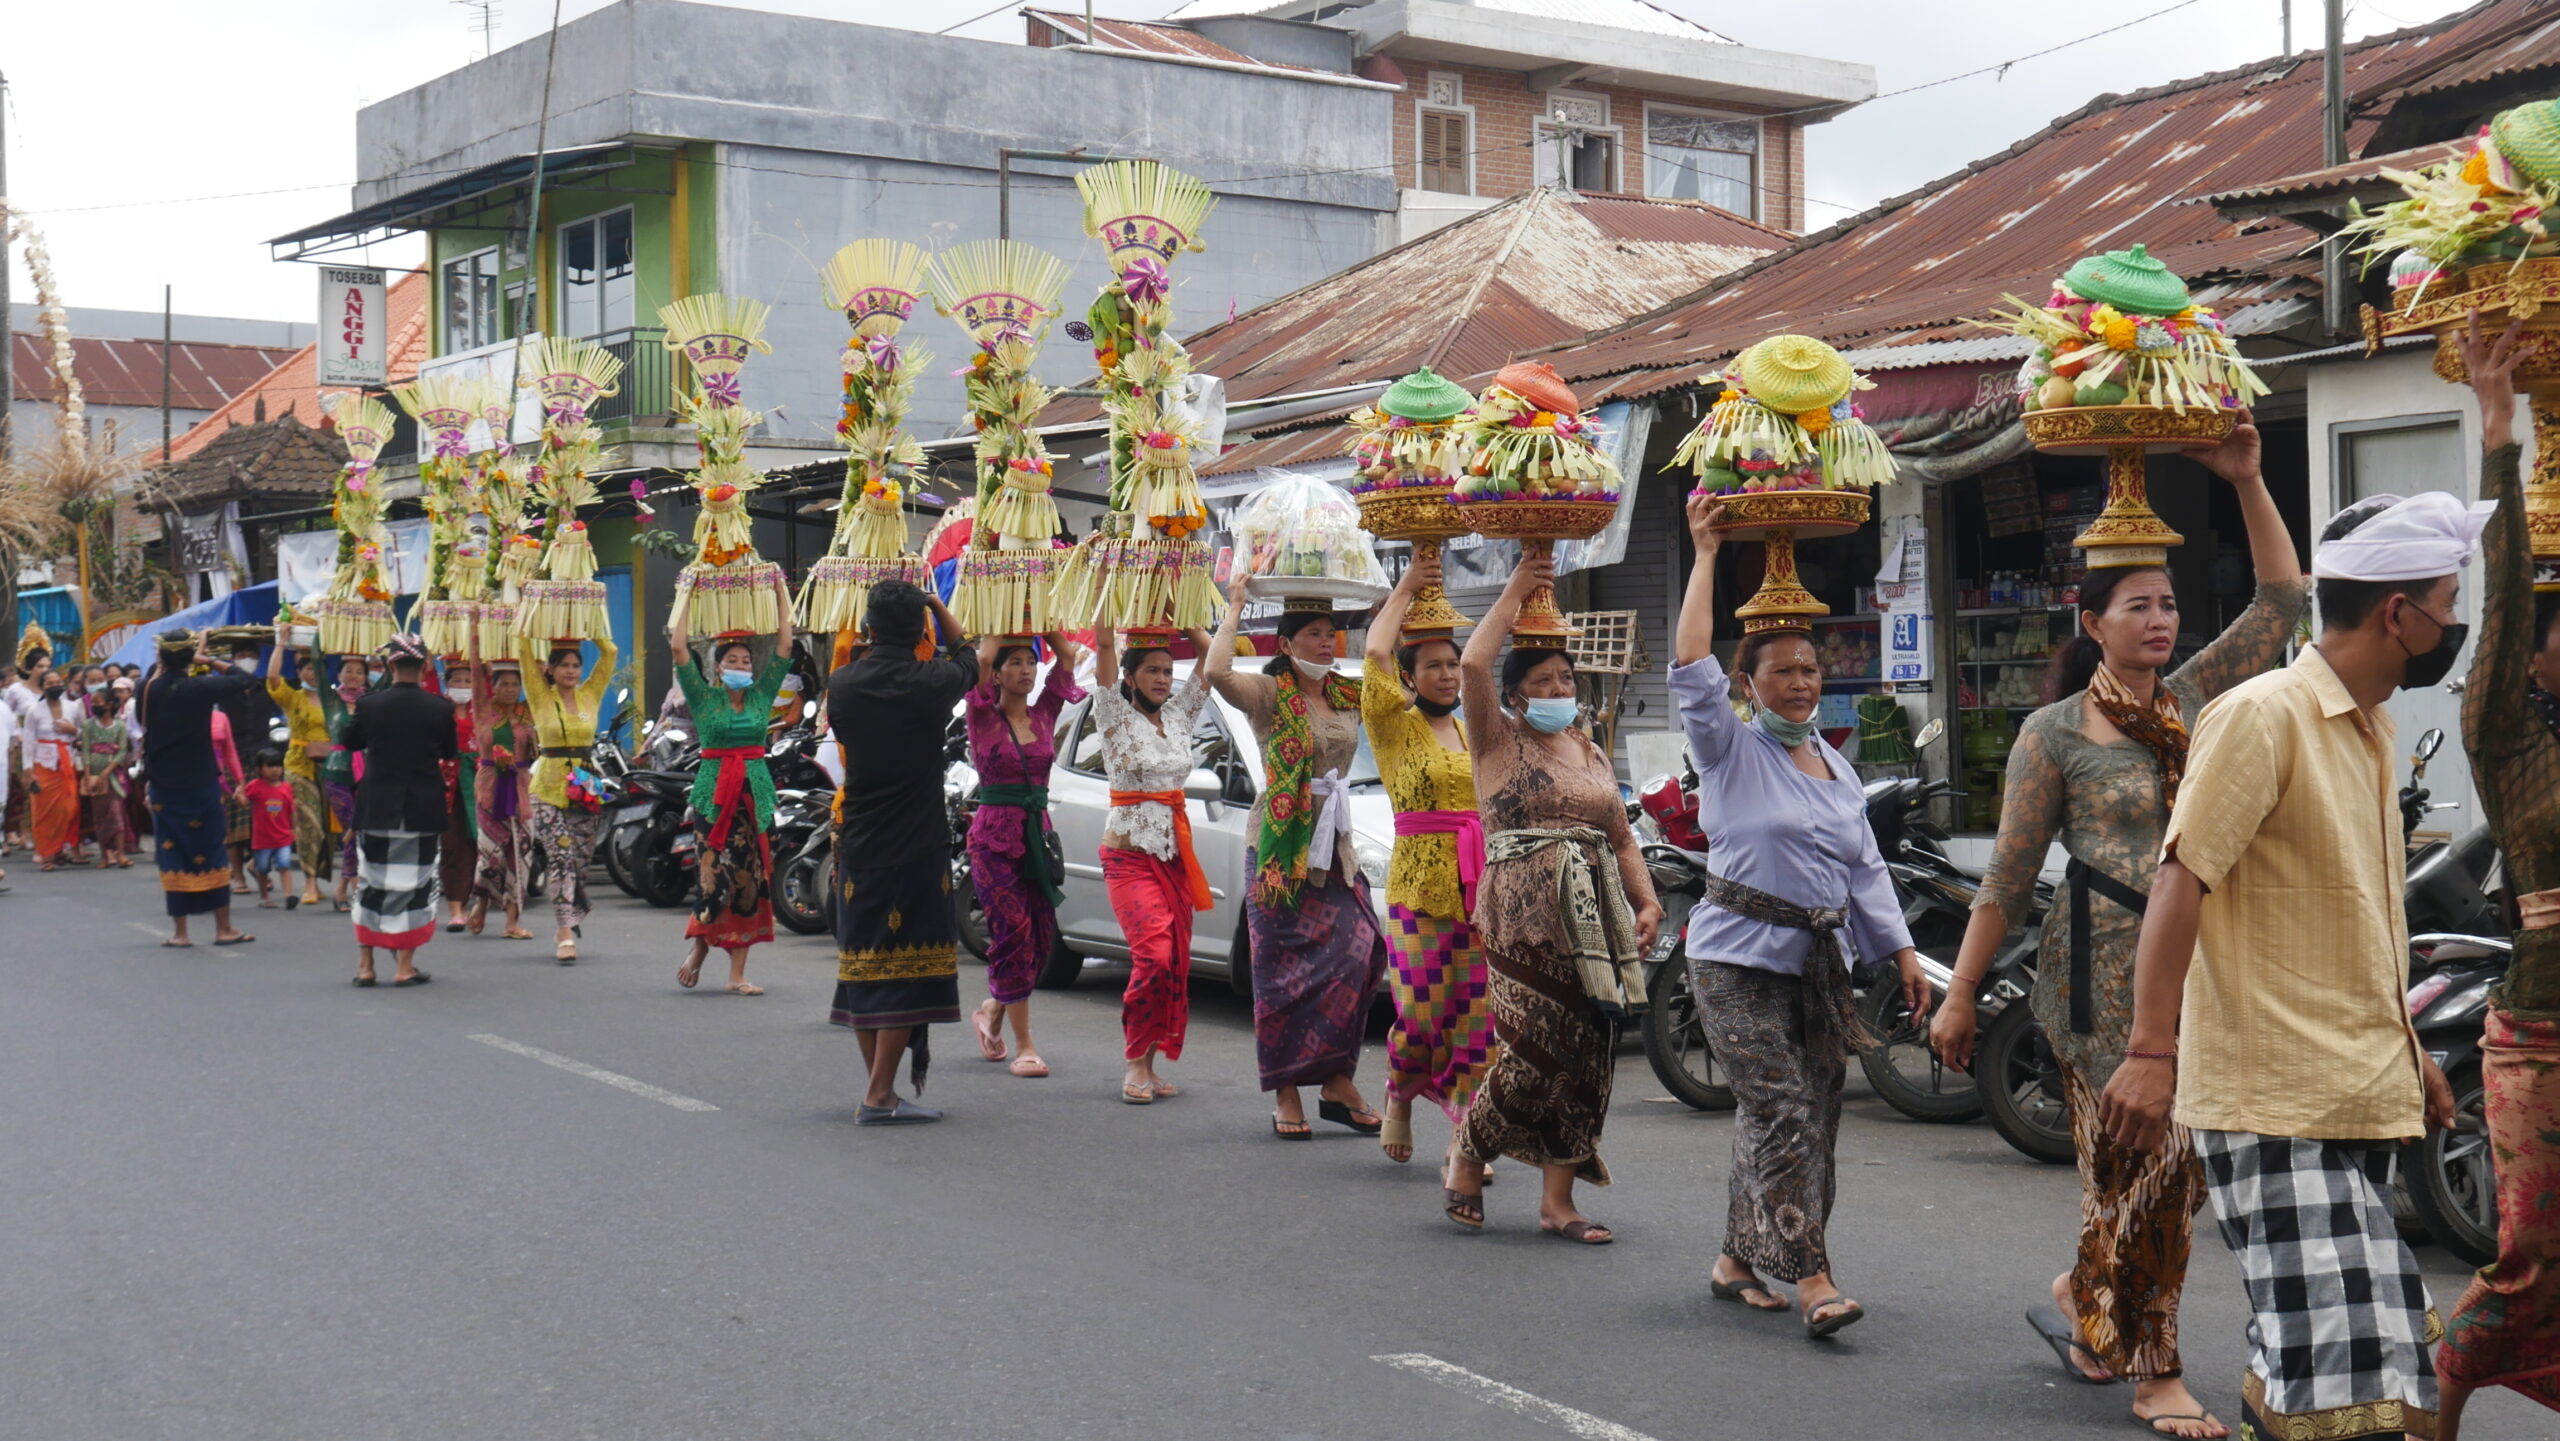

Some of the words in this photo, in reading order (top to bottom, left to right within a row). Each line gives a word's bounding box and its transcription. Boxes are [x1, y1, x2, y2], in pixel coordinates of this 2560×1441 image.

[328, 270, 382, 286] TOSERBA
[343, 287, 365, 360] ANGGI
[326, 353, 381, 375] Jaya
[1449, 532, 1484, 551] SELERA
[1252, 603, 1263, 619] 20
[1909, 665, 1918, 675] 12
[1659, 935, 1677, 948] PE
